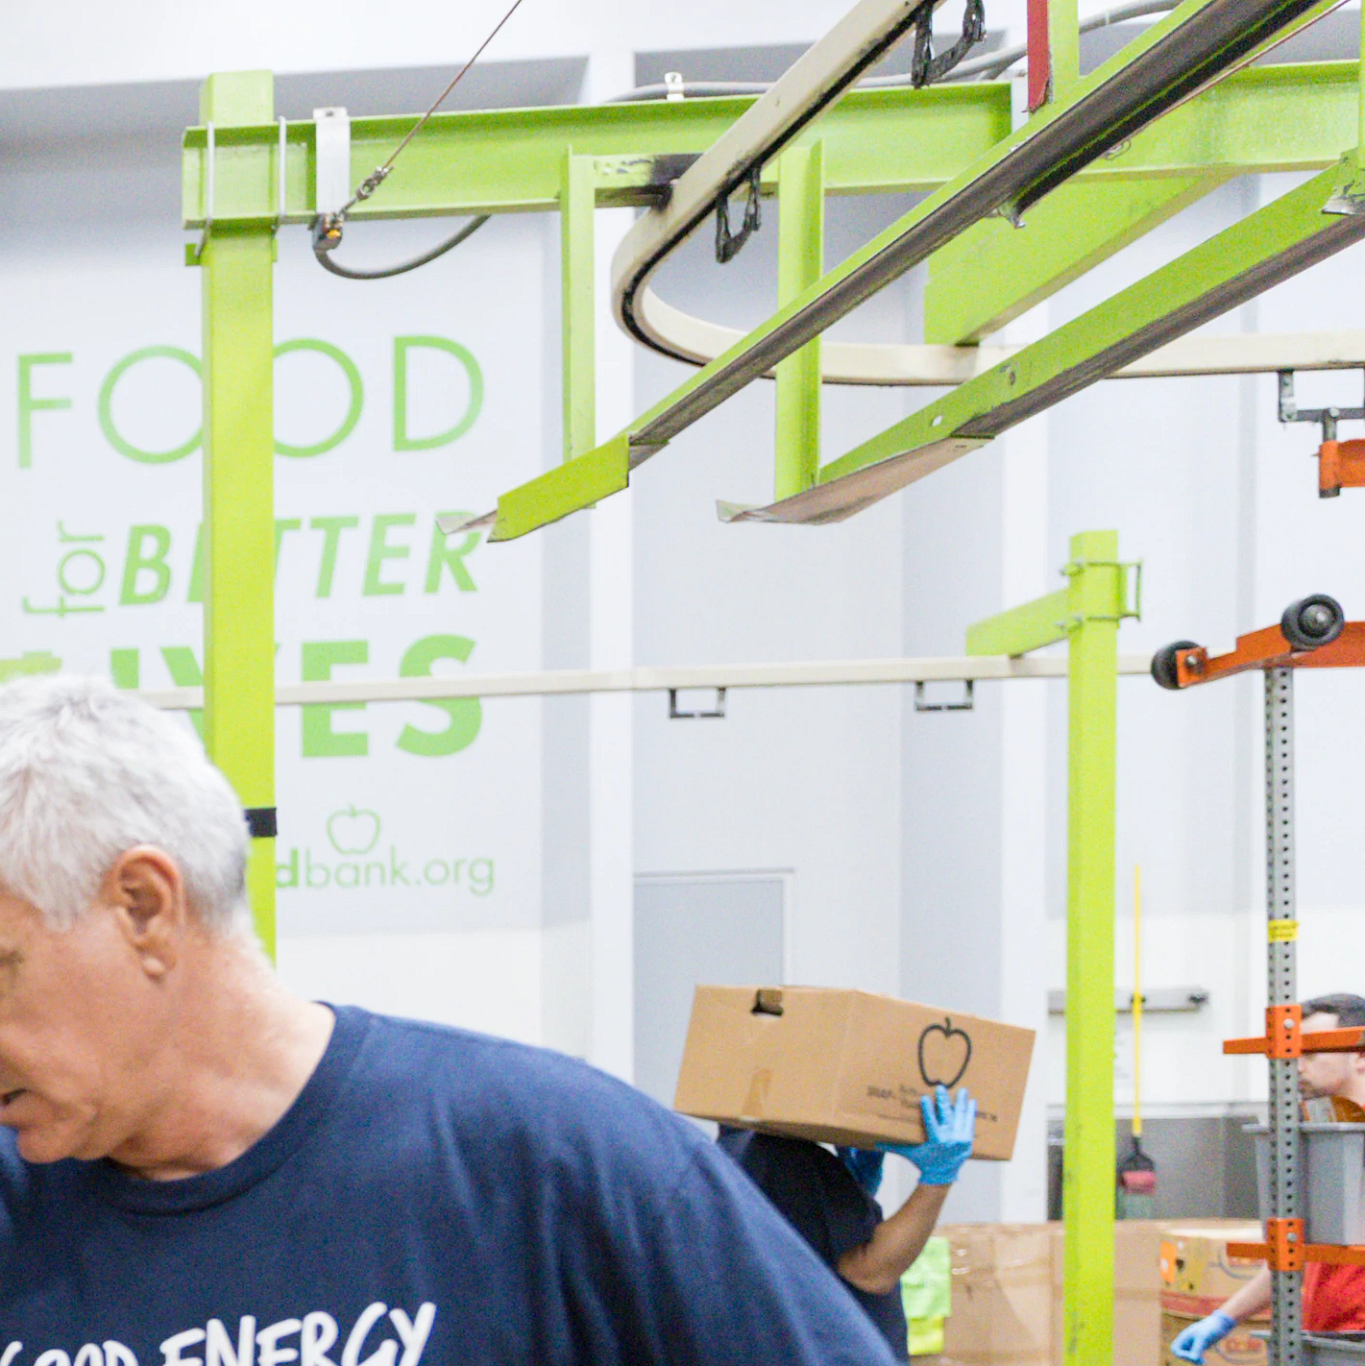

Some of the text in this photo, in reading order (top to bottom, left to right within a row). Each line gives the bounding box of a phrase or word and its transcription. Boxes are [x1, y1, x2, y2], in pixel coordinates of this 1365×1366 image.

[17, 336, 485, 469] FOOD
[22, 519, 105, 619] for
[275, 845, 495, 897] dbank.org
